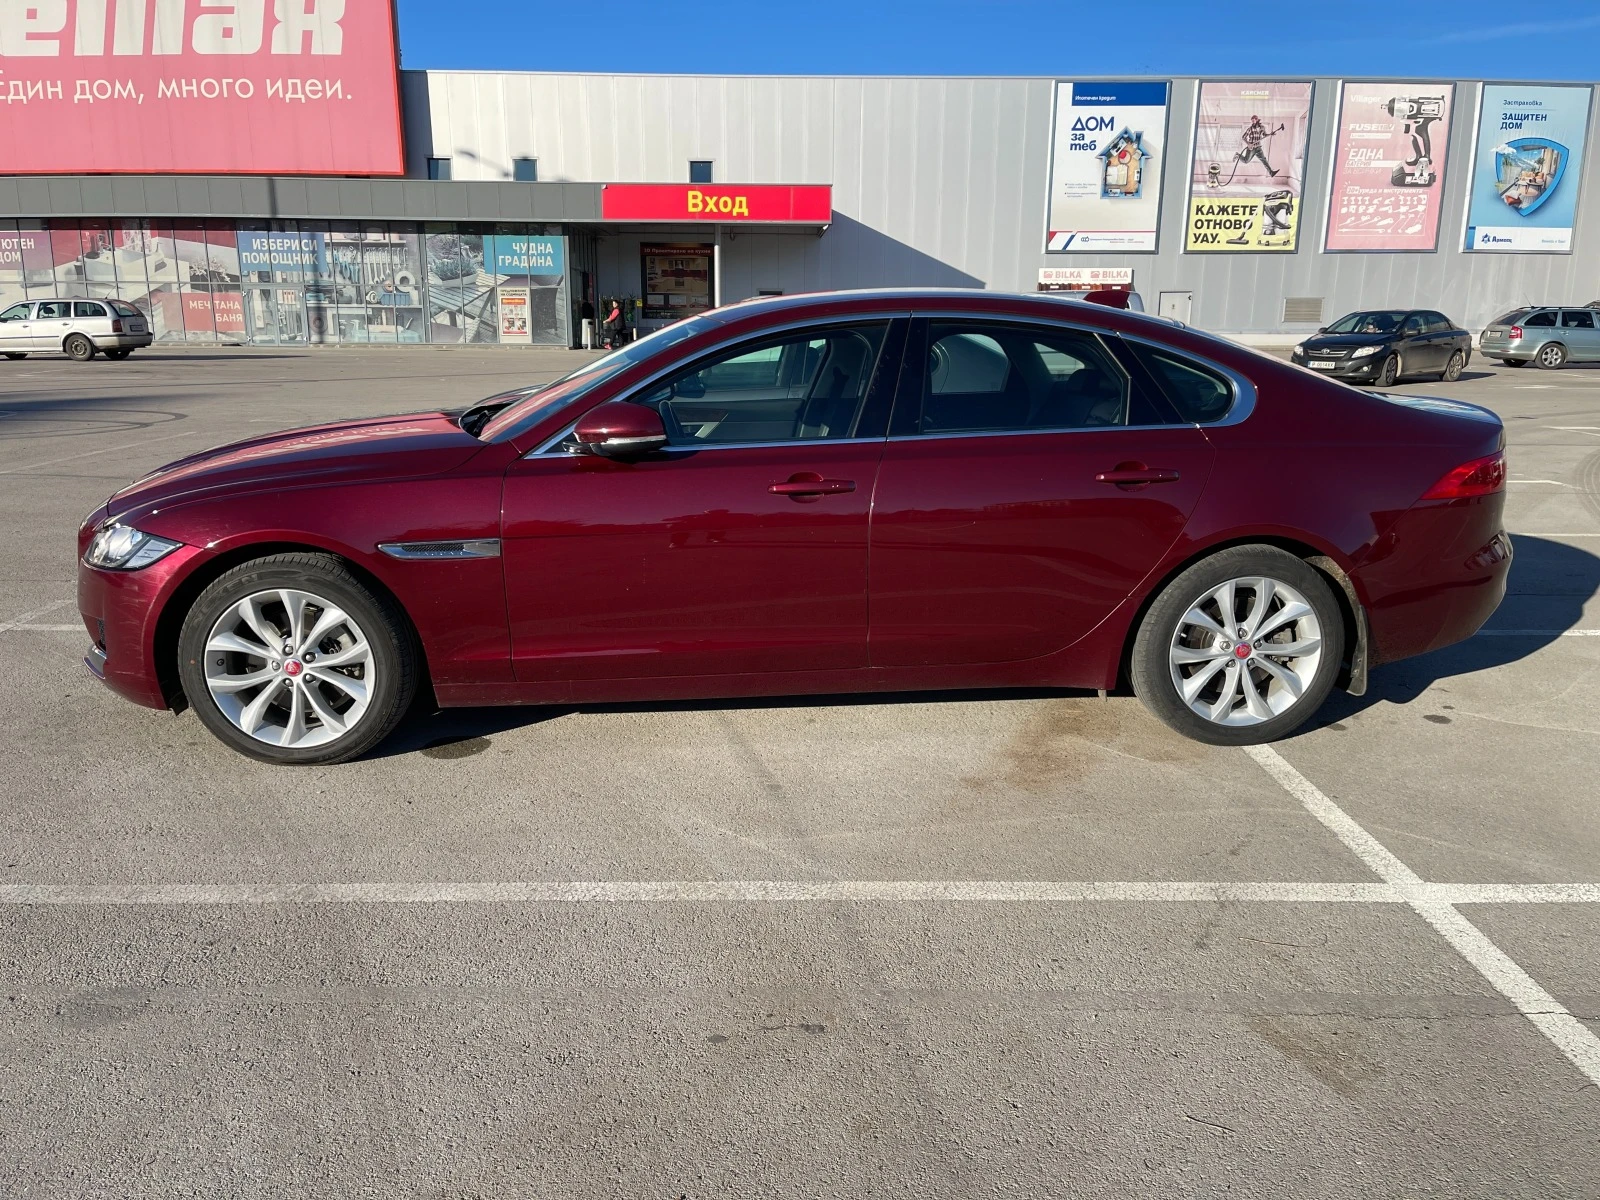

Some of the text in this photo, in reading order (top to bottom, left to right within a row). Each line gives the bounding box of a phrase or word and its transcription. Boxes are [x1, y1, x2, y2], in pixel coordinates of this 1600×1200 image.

[74, 79, 145, 104] дом,
[158, 78, 254, 99] много
[266, 78, 352, 103] идеи.
[1502, 113, 1547, 122] ЗАЩИТЕН
[1071, 116, 1115, 131] ДОМ
[1500, 122, 1523, 130] ДОМ
[1071, 133, 1085, 141] за
[1070, 140, 1097, 151] теб
[1348, 148, 1384, 161] ЕДНА
[687, 191, 749, 216] Вход
[1195, 205, 1258, 216] КАЖЕТЕ
[1194, 219, 1253, 230] ОТНОВО
[1193, 233, 1221, 244] УАУ.
[252, 238, 318, 251] ИЗБЕРИ СИ
[512, 242, 553, 255] ЧУДНА
[242, 252, 319, 267] ПОМОЩНИК
[498, 255, 553, 268] ГРАДИНА
[1055, 271, 1082, 279] BILKA
[1102, 271, 1129, 279] BILKA
[189, 300, 240, 310] МЕЧТАНА
[216, 312, 243, 323] БАНЯ
